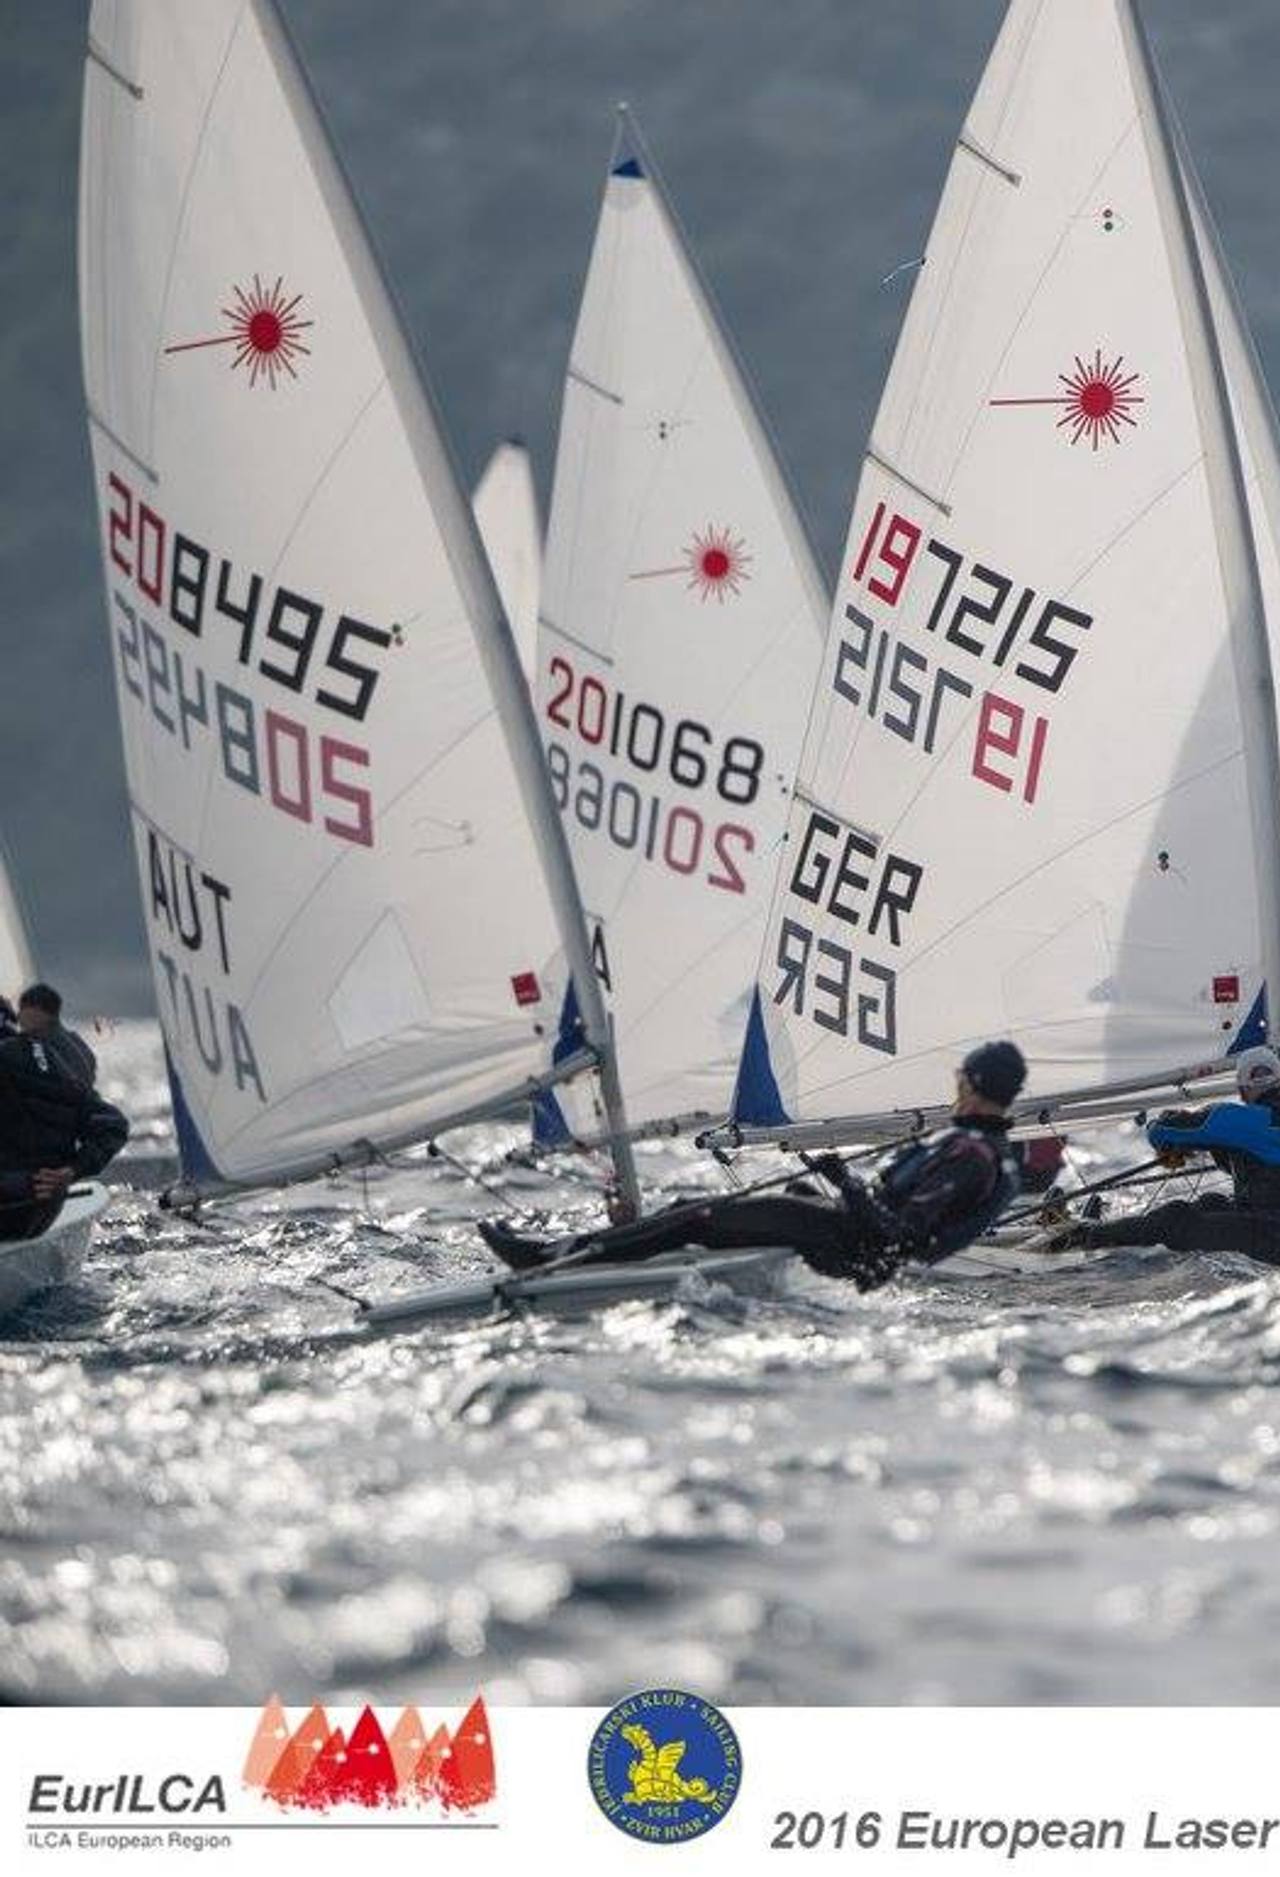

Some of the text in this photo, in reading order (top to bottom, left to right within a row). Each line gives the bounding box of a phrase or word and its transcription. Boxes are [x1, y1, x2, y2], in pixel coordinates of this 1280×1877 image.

[110, 471, 392, 721] 208495
[854, 502, 1093, 694] 197215
[547, 657, 765, 806] 201068
[149, 831, 231, 975] AUT
[790, 813, 922, 946] GER
